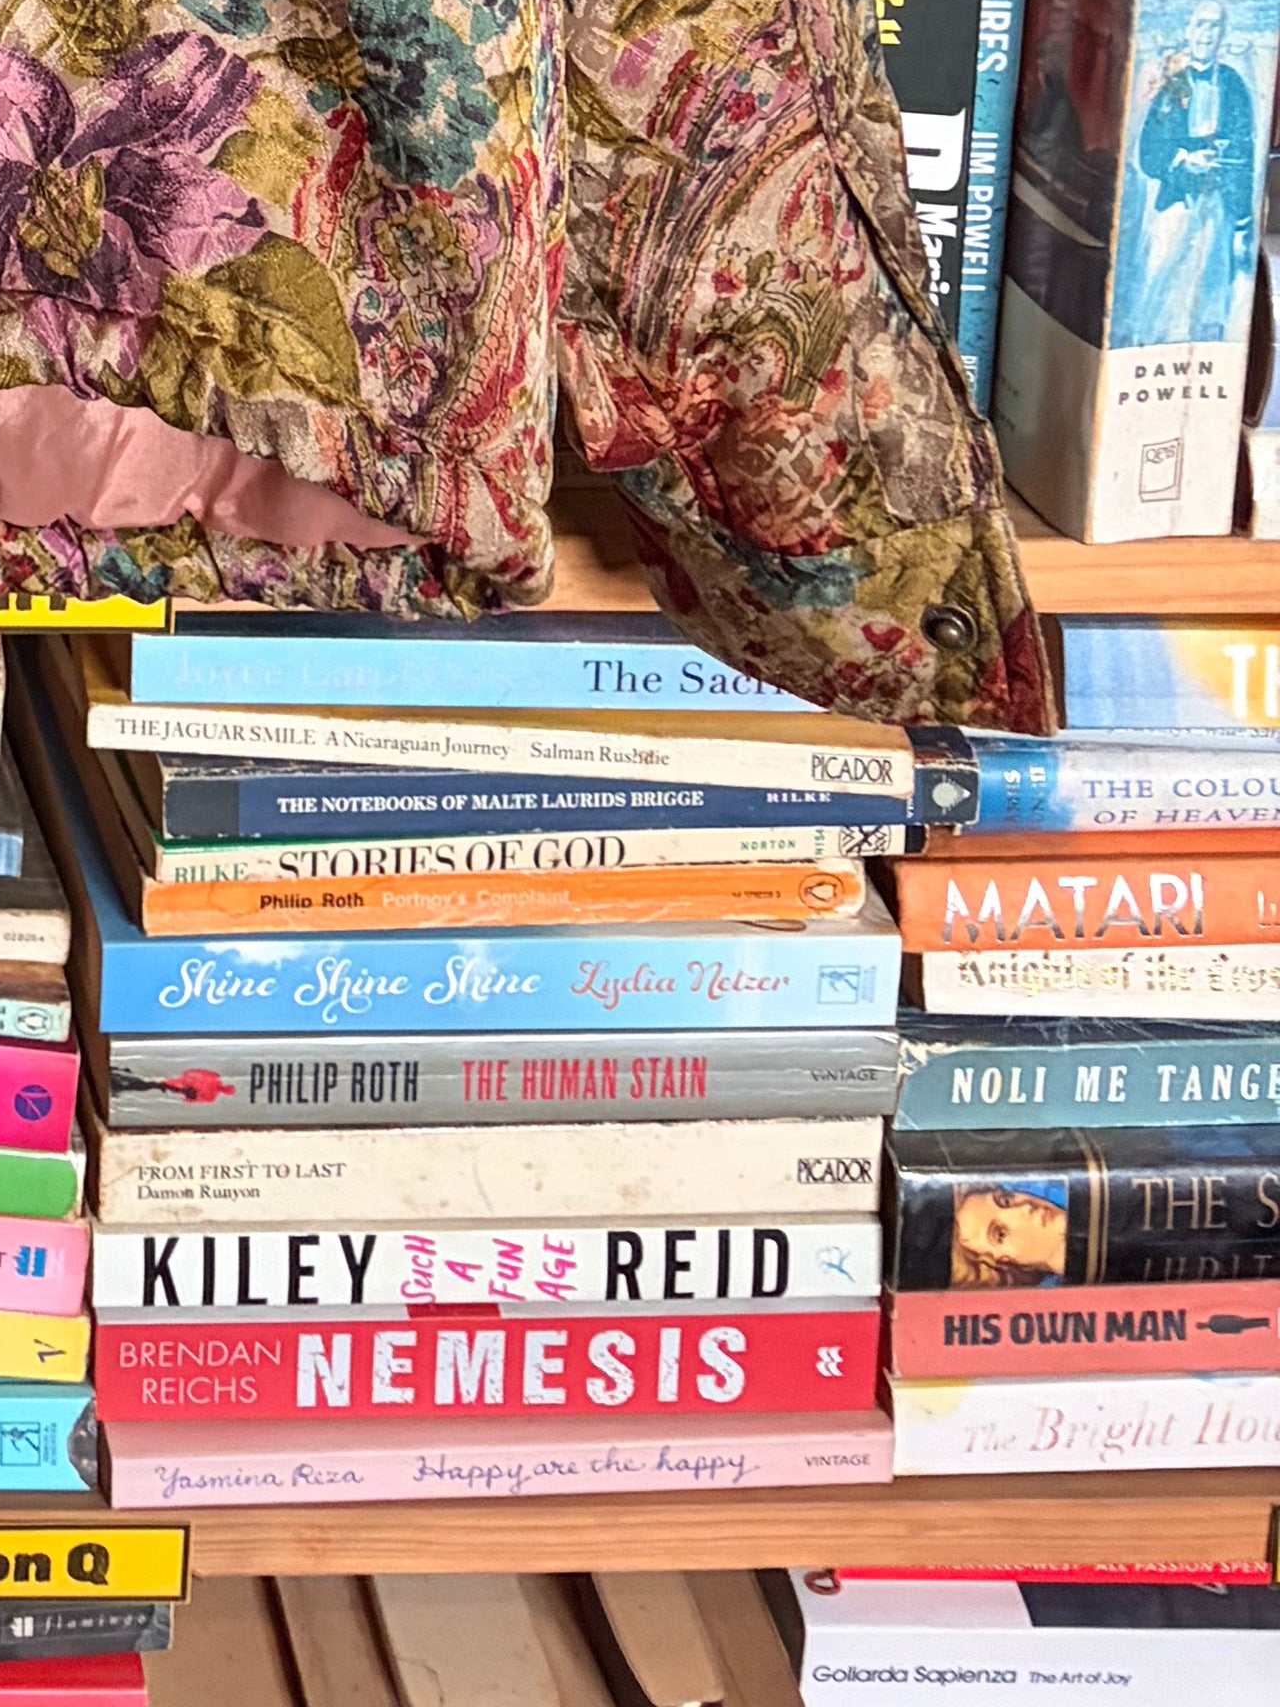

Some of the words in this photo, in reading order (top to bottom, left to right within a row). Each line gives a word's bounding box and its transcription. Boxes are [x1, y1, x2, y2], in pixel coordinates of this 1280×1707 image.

[1133, 359, 1216, 381] DAWN
[1116, 382, 1230, 406] POWELL
[248, 1062, 339, 1104] PHILIP
[351, 1060, 420, 1103] ROTH
[461, 1059, 512, 1102] THE
[520, 1058, 618, 1100] HUMAN
[629, 1056, 707, 1099] STAIN
[137, 1164, 195, 1182] FROM
[199, 1163, 258, 1180] FIRST
[262, 1163, 288, 1179] TO
[294, 1161, 346, 1179] LAST
[141, 1233, 378, 1308] KILEY
[604, 1227, 790, 1301] REID
[943, 1313, 1001, 1347] HIS
[1009, 1312, 1097, 1345] OWN
[1103, 1310, 1187, 1343] MAN
[295, 1326, 747, 1409] NEMESIS
[66, 1541, 112, 1586] Q
